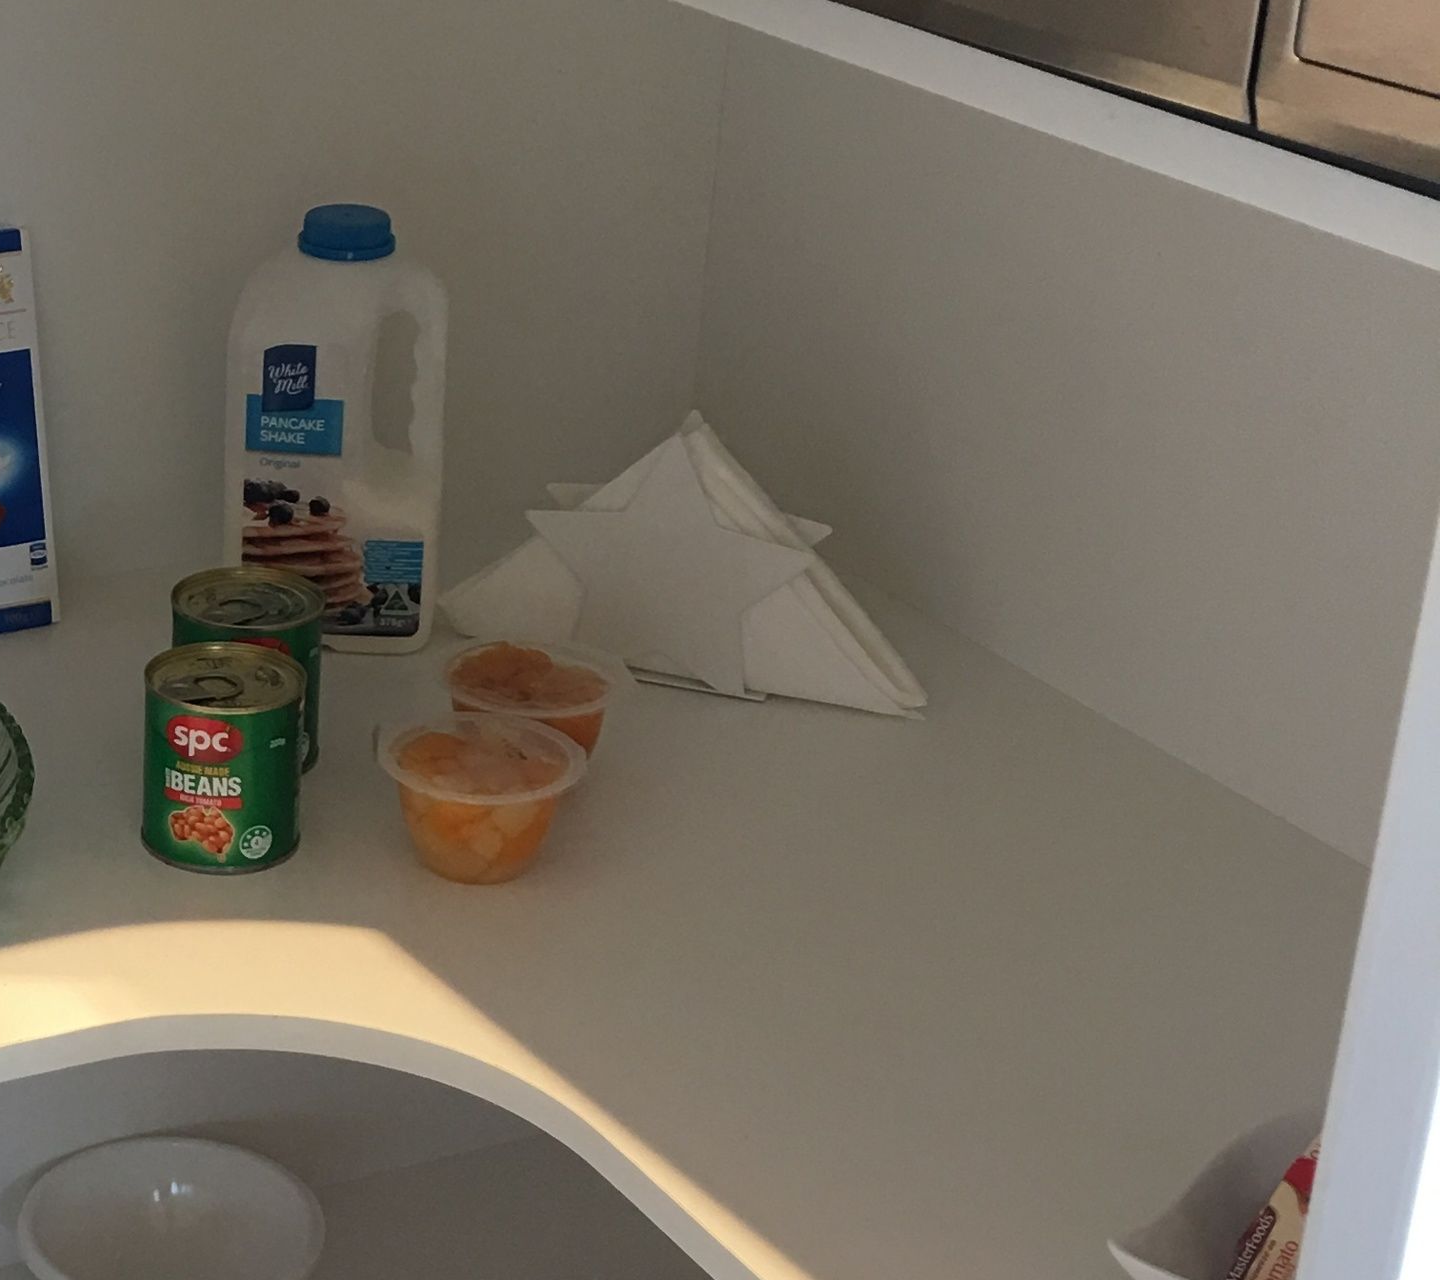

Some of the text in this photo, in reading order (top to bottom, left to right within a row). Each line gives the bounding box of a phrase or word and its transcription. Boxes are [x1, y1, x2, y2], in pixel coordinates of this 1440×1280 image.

[267, 362, 310, 381] White
[260, 415, 326, 432] PANCAKE
[260, 430, 306, 445] SHAKE
[173, 725, 229, 758] spc
[203, 766, 230, 778] MADE
[170, 769, 243, 798] BEANS
